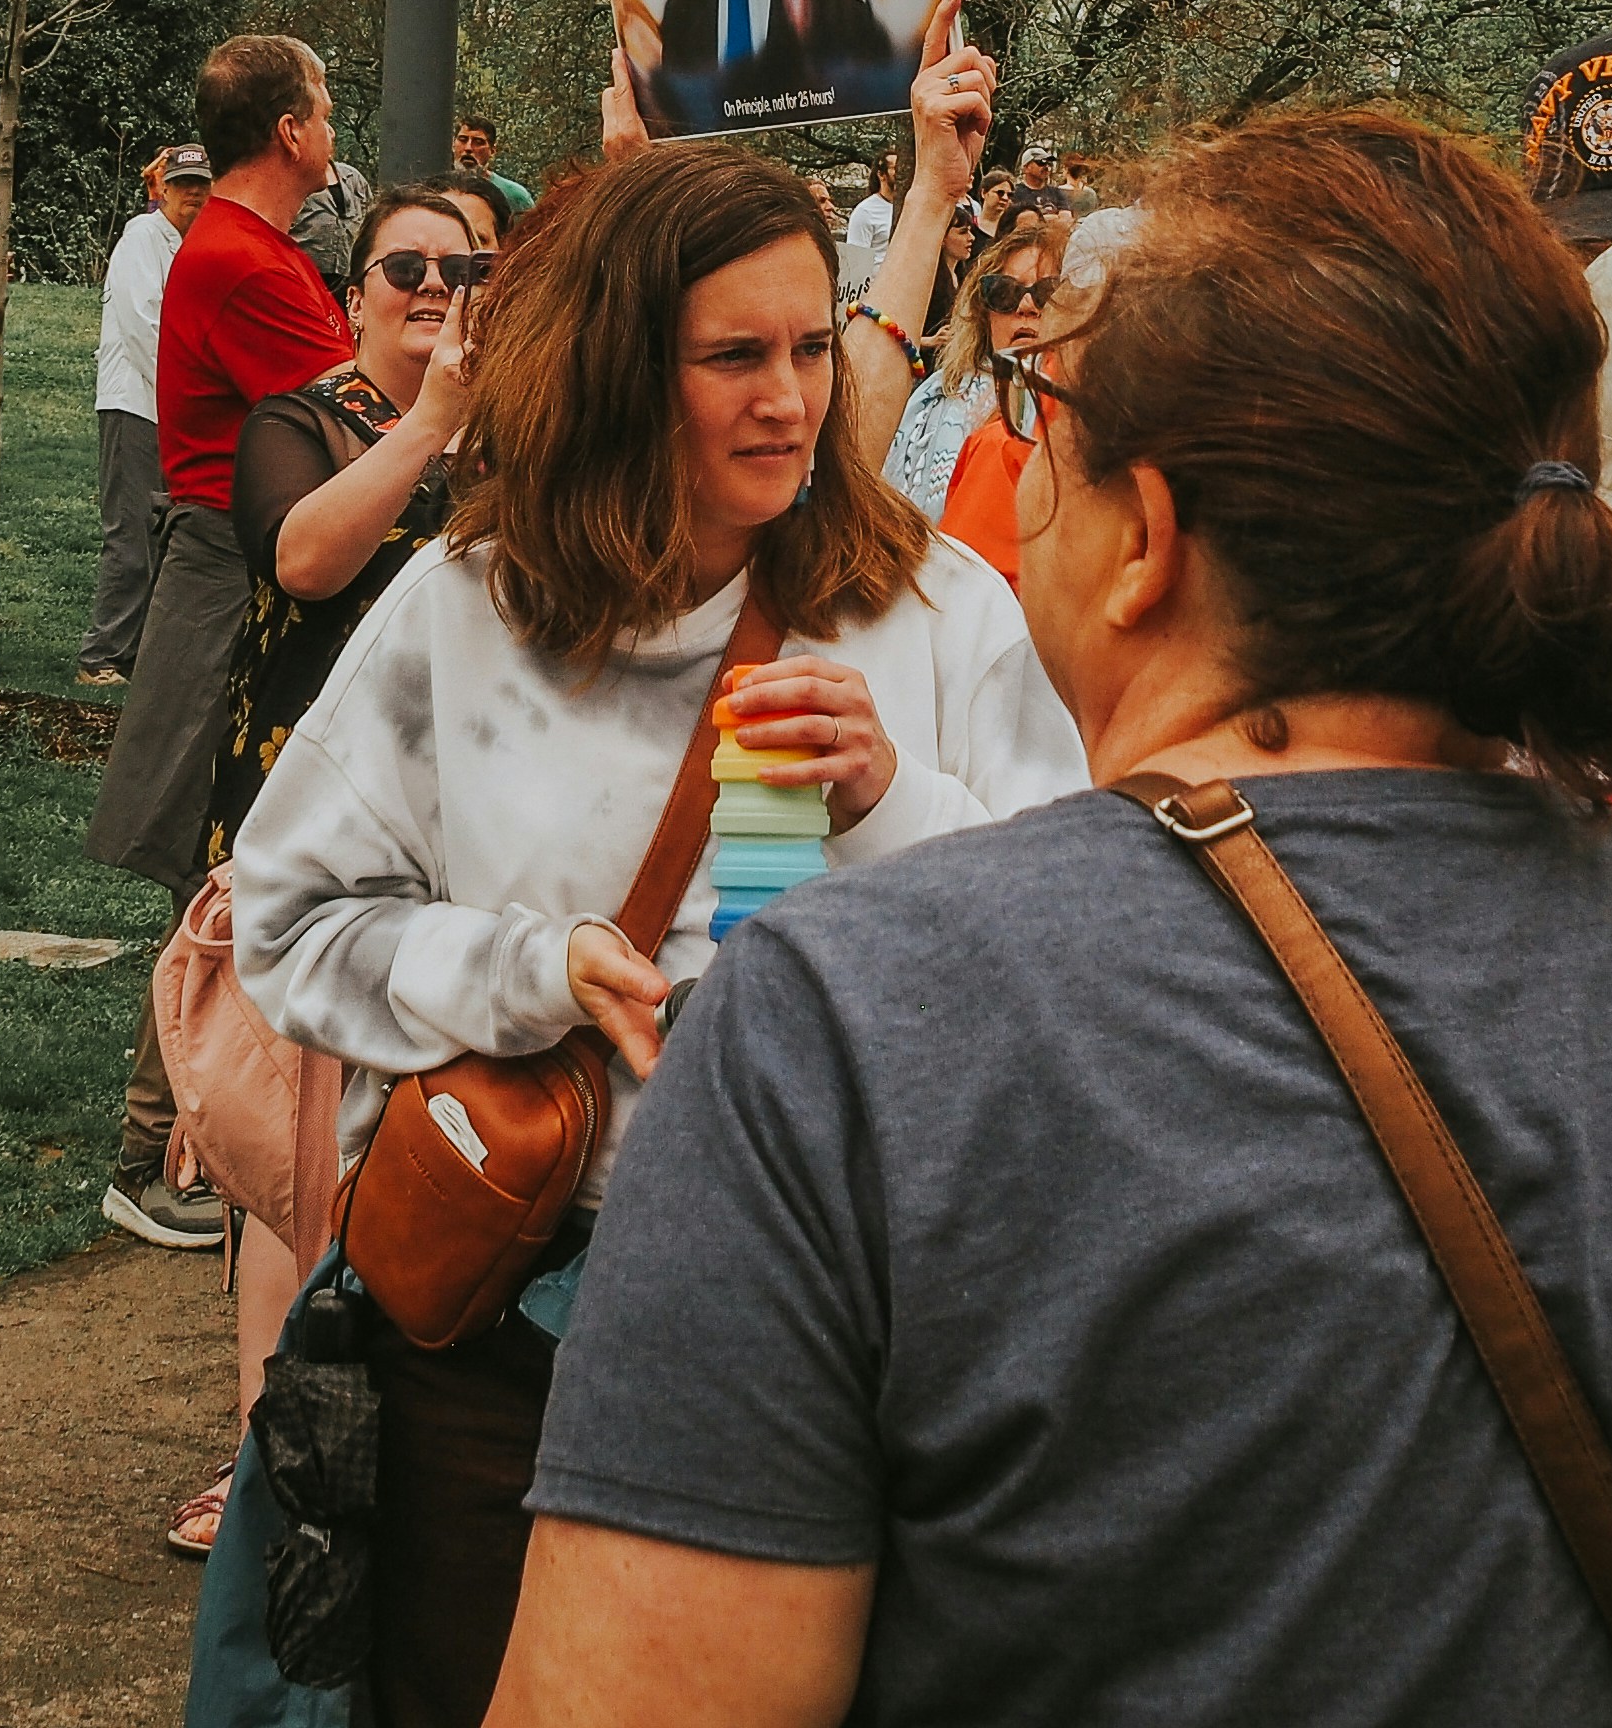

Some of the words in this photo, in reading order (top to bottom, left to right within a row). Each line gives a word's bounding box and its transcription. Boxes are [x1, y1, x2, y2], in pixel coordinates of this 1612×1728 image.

[723, 100, 736, 117] On
[736, 96, 773, 117] Principle,
[772, 94, 786, 112] not
[786, 92, 798, 109] for
[809, 86, 836, 105] hours!
[1573, 93, 1603, 128] UNITED
